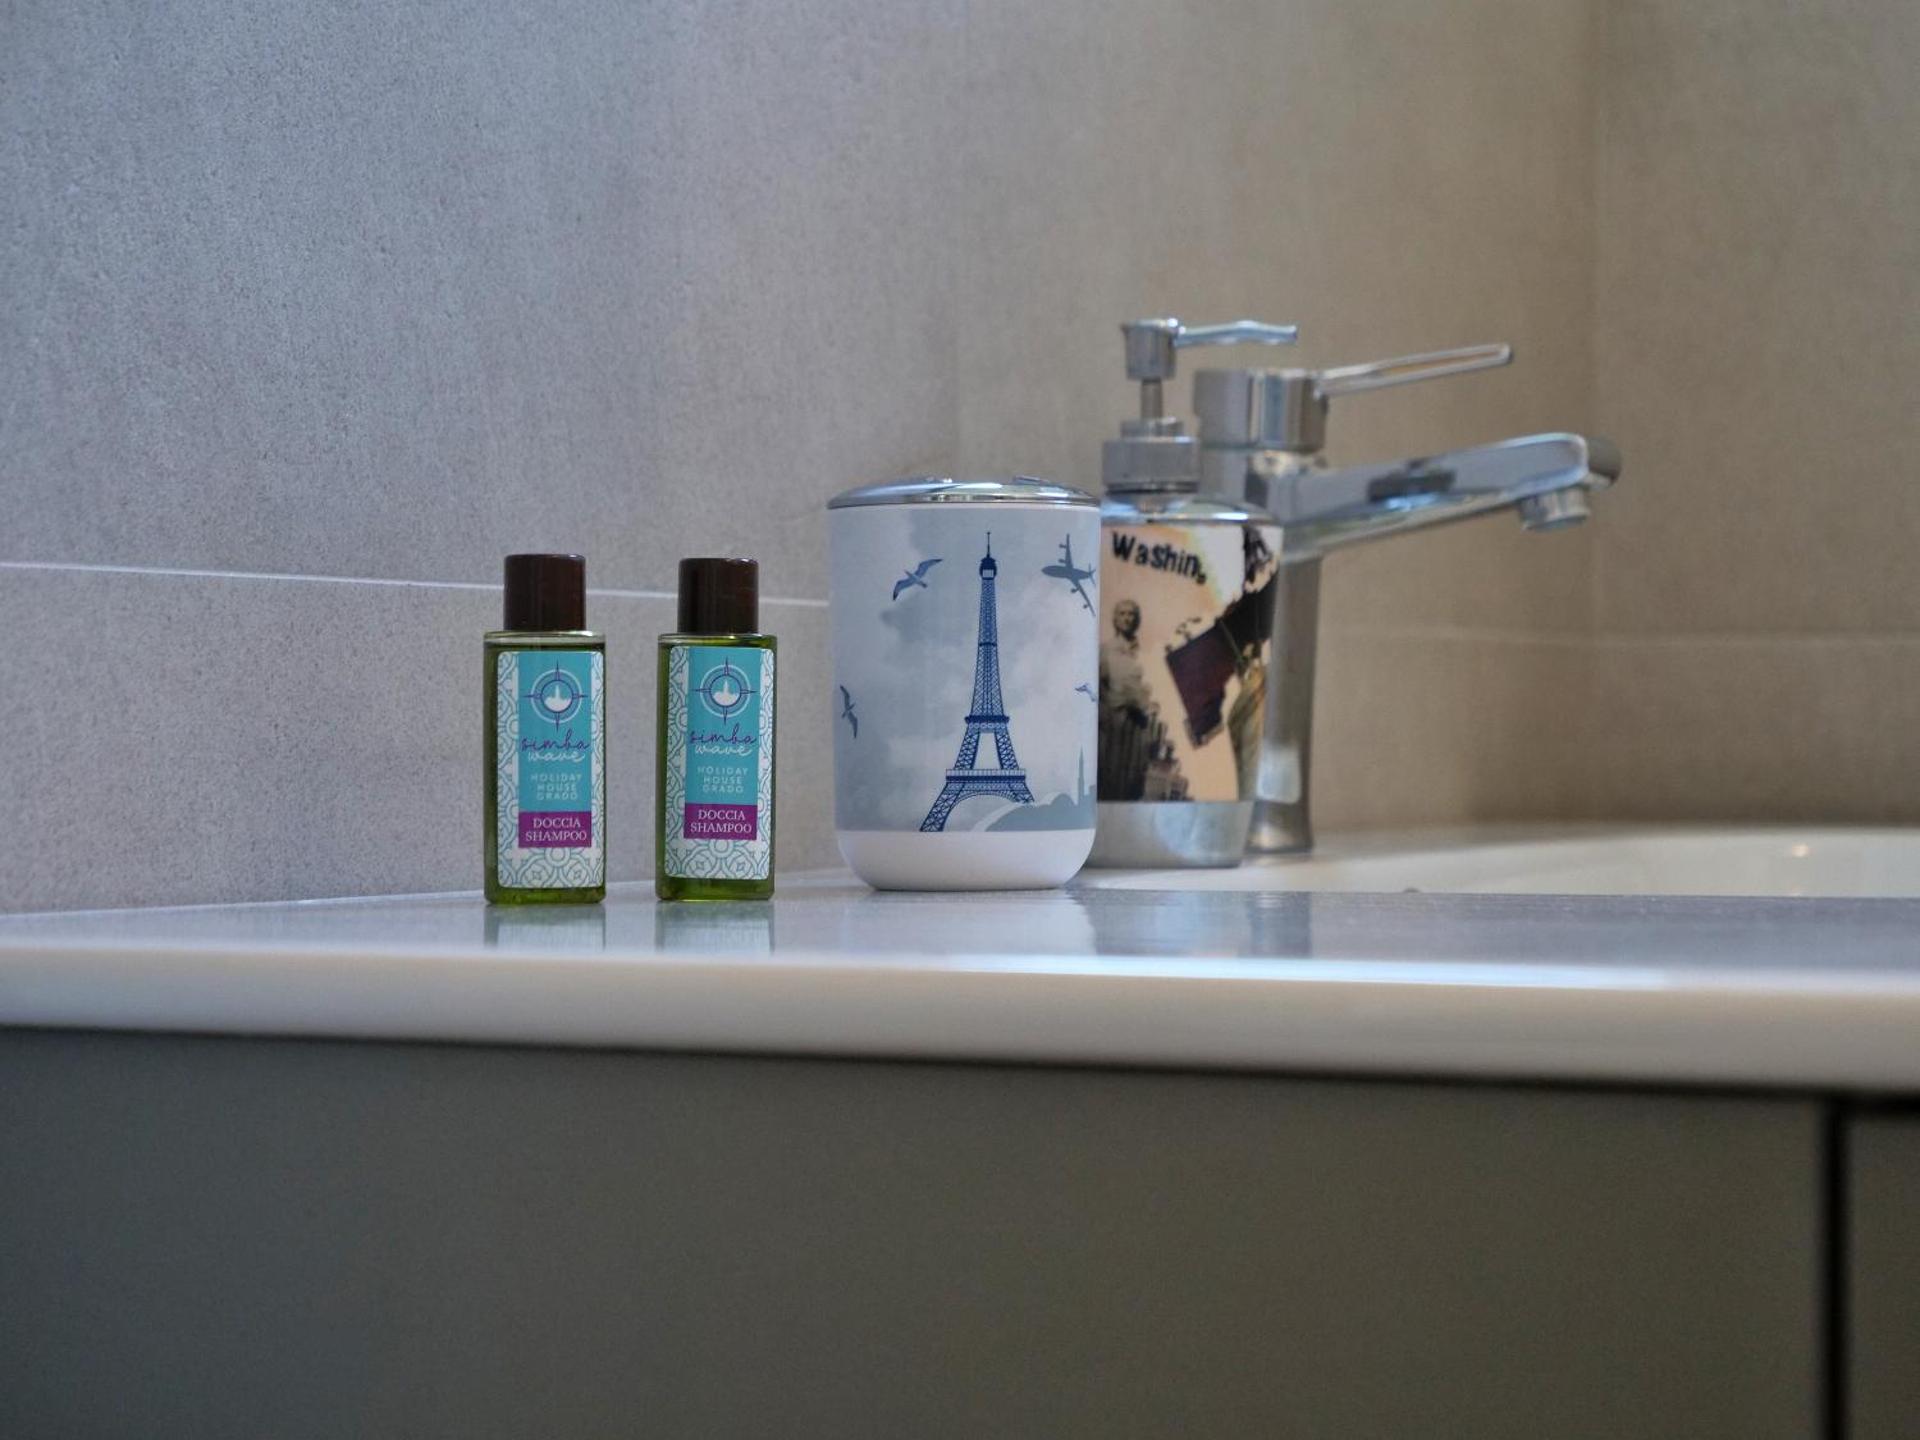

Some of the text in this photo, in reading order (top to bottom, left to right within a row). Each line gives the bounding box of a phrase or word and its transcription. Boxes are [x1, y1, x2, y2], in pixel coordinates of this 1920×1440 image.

[697, 766, 749, 775] HOLIDAY
[530, 773, 582, 781] HOLIDAY
[703, 776, 743, 784] HOUSE
[537, 782, 577, 791] HOUSE
[698, 809, 745, 821] DOCCIA
[533, 817, 581, 829] DOCCIA
[690, 822, 752, 833] SHAMPOO
[525, 830, 587, 842] SHAMPOO
